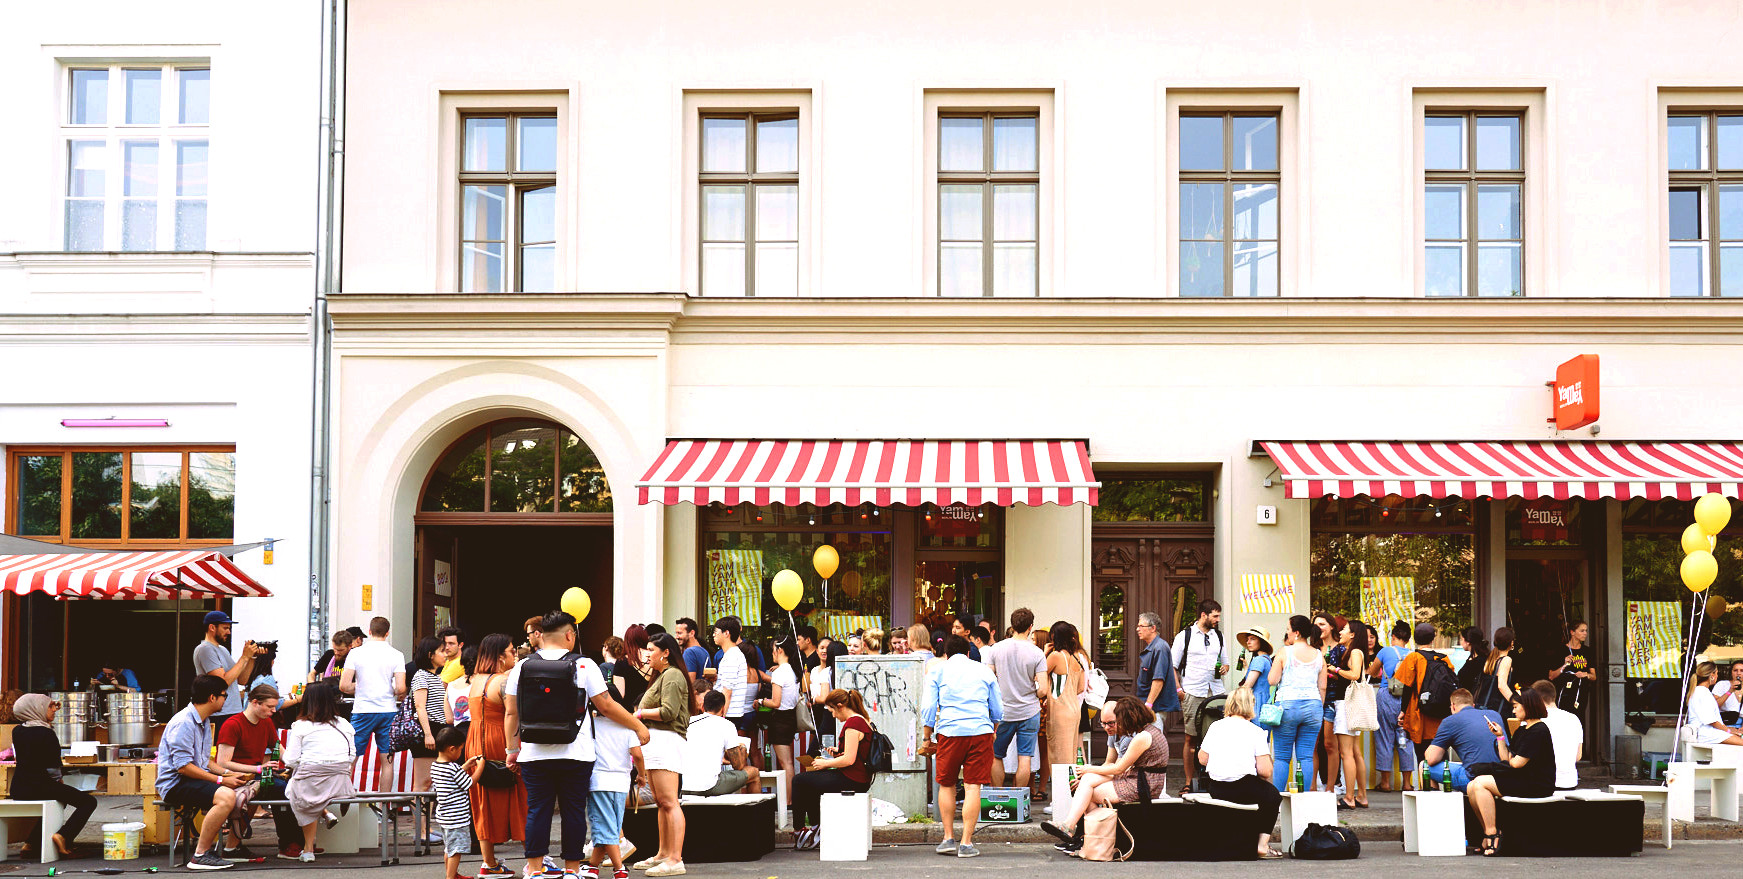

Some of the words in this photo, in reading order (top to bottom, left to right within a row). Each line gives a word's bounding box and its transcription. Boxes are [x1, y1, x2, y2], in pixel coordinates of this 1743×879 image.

[1264, 509, 1270, 519] 6
[712, 562, 734, 572] YAM
[712, 570, 734, 581] YAM
[1243, 585, 1293, 601] WELCOME
[1363, 589, 1386, 600] YAM
[1630, 614, 1652, 625] YAM
[1630, 622, 1652, 633] YAM
